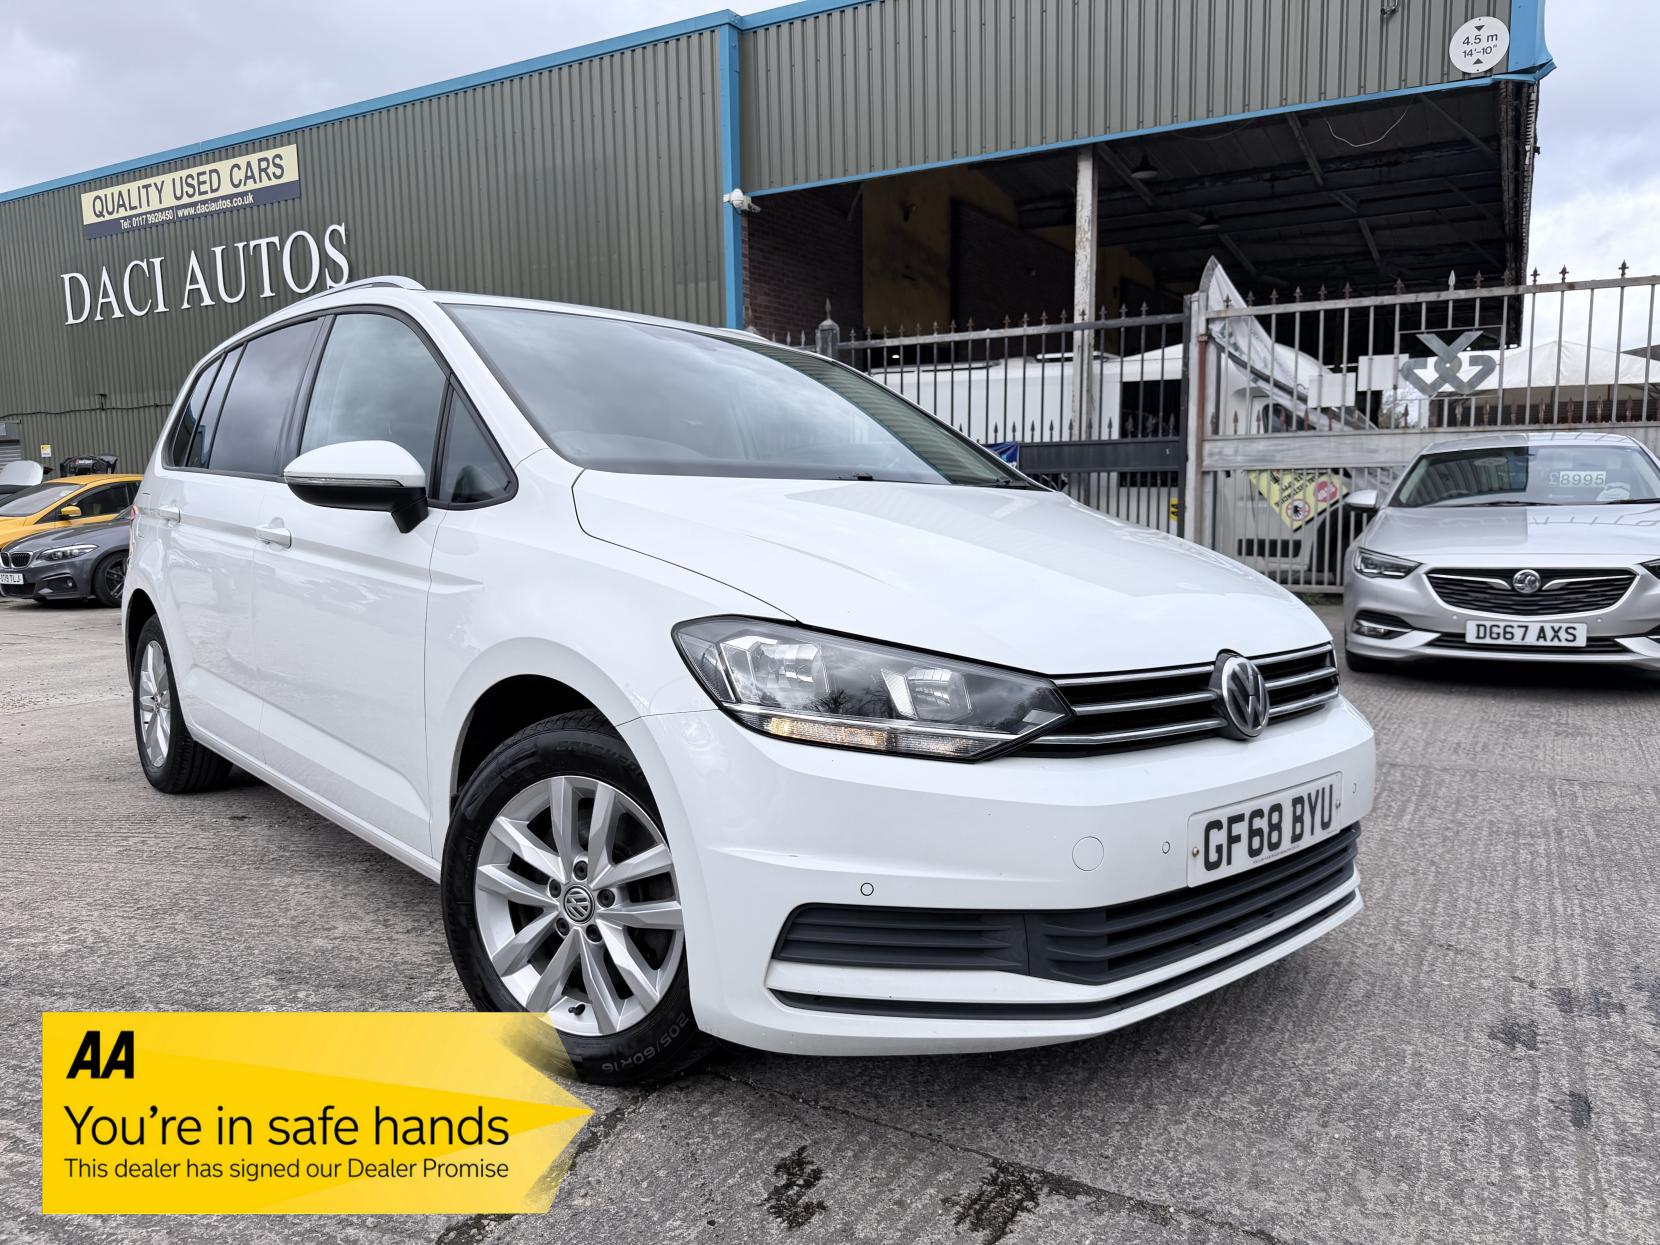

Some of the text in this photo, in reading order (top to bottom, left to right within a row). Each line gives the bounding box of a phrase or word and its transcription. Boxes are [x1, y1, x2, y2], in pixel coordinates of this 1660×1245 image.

[1462, 33, 1498, 46] 4.5 m
[92, 153, 285, 219] QUALITY USED CARS
[119, 219, 132, 230] Tel:
[132, 216, 146, 227] 0117
[177, 192, 254, 218] www.daciautos.co.uk
[60, 222, 350, 325] DACI AUTOS
[1548, 471, 1604, 486] £8995
[1475, 623, 1577, 643] DG67 AXS
[1203, 784, 1334, 872] GF68 BYU
[601, 1012, 690, 1074] 205/60R16
